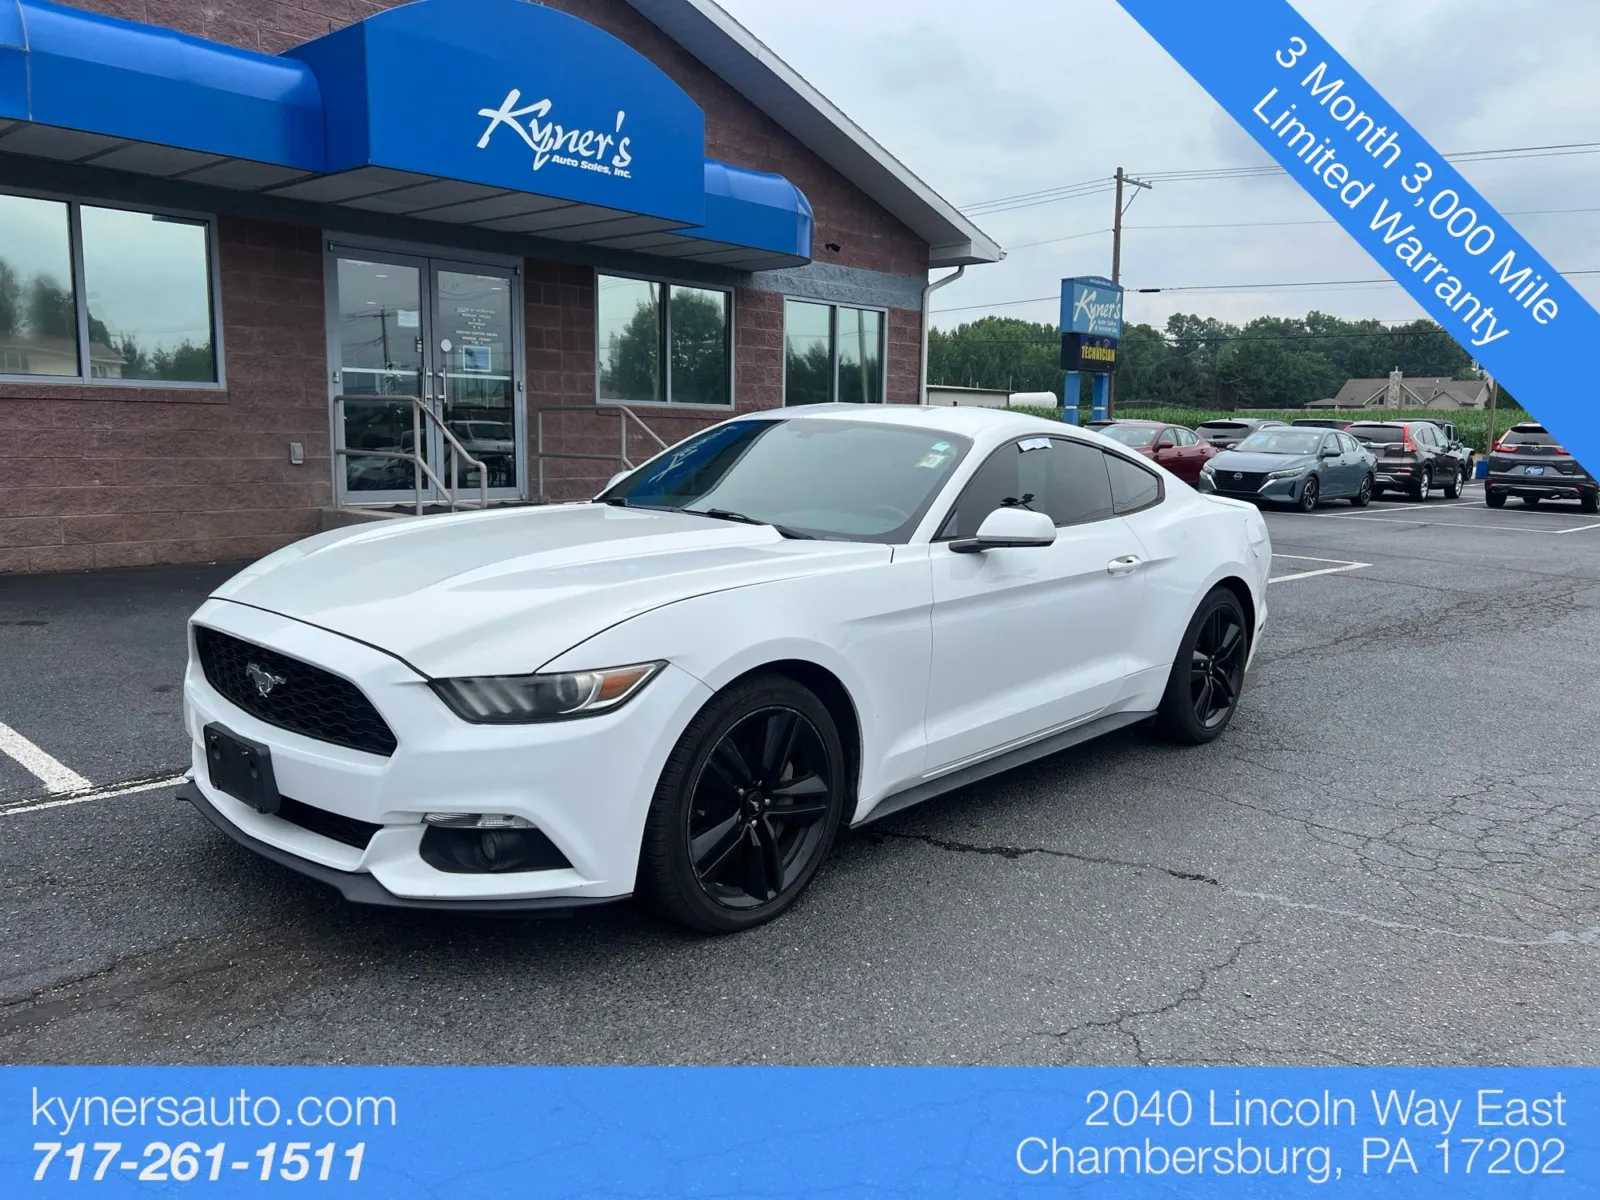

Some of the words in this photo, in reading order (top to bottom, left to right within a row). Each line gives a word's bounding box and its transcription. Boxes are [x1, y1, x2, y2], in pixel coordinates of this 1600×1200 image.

[477, 88, 632, 171] Kyner's
[551, 154, 579, 167] Auto
[580, 160, 611, 175] Sales,
[614, 167, 632, 179] Inc.
[1073, 288, 1121, 332] Kyner's
